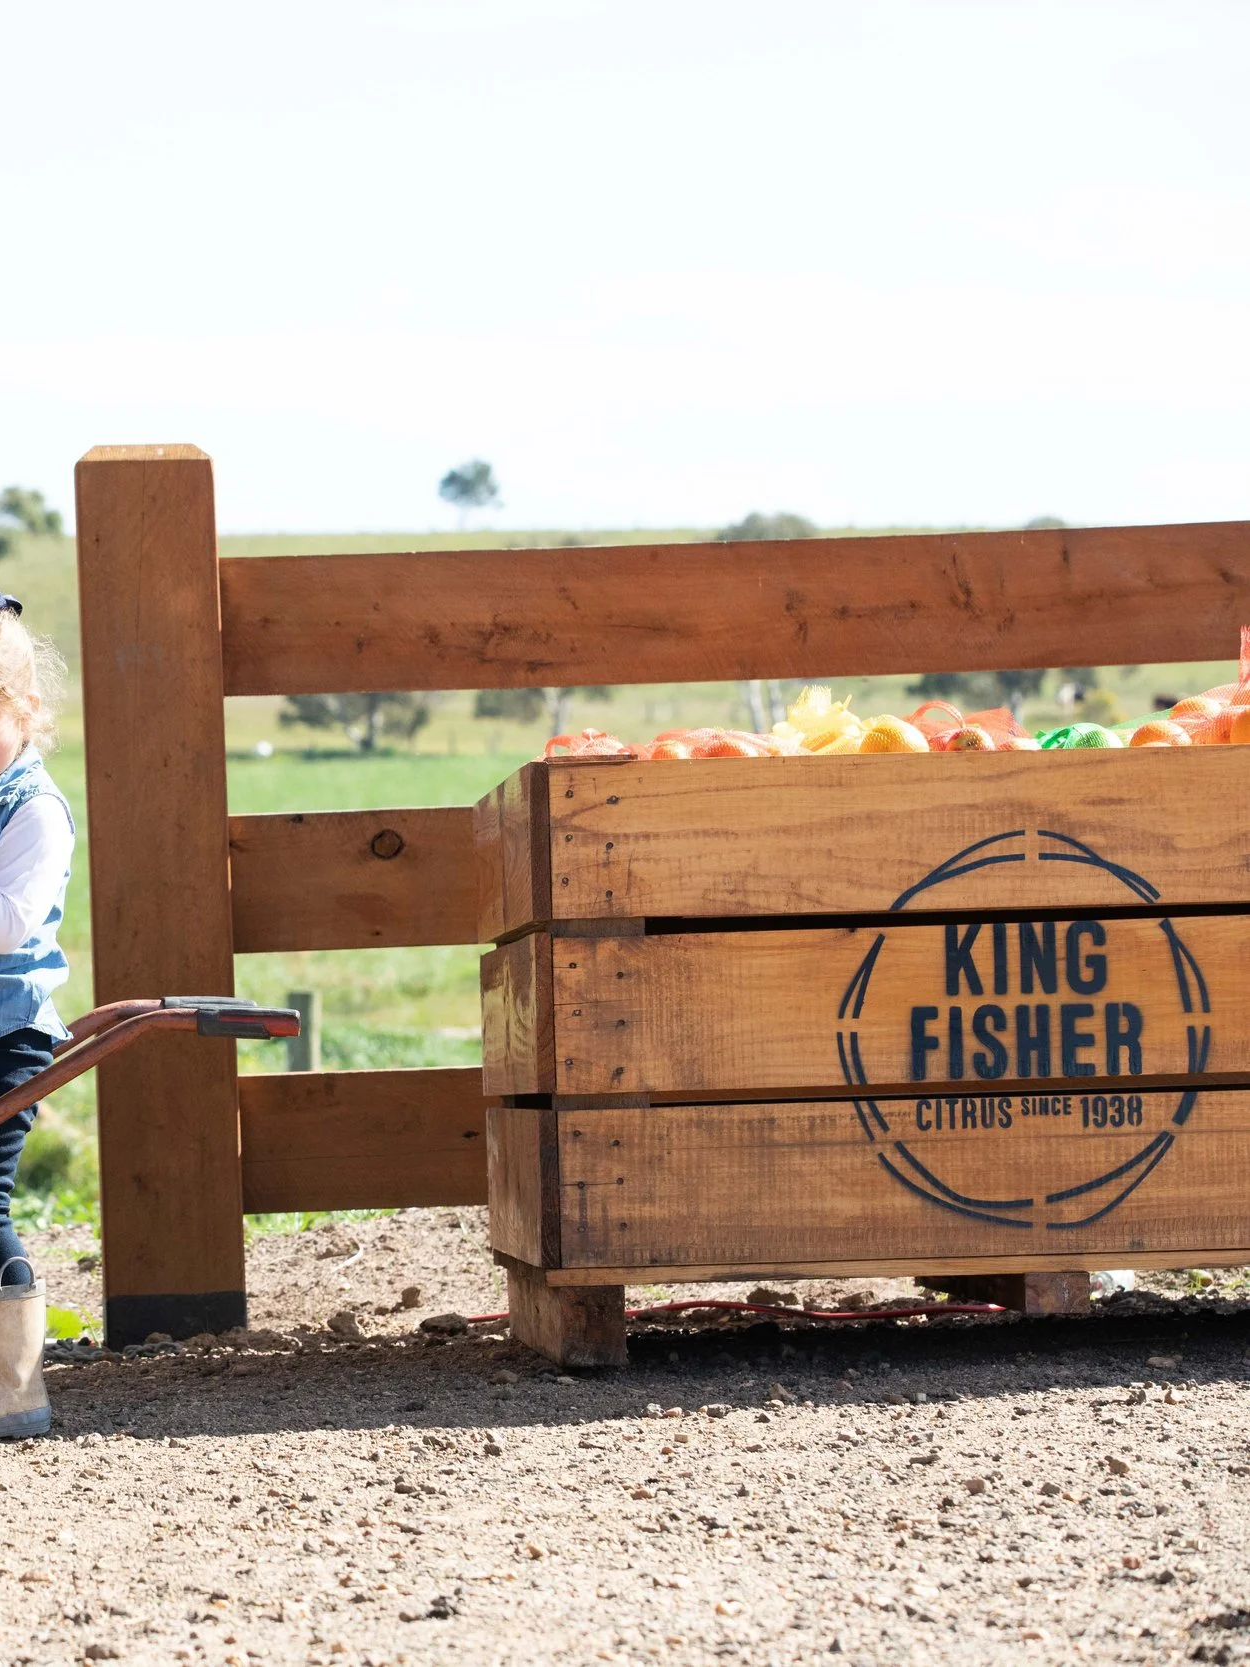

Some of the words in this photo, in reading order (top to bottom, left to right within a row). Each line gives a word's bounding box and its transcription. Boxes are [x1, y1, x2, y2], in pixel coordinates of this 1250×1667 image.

[945, 921, 1107, 995] KING
[911, 1003, 1143, 1081] FISHER
[916, 1097, 1013, 1131] CITRUS
[1021, 1097, 1072, 1116] SINCE
[1080, 1096, 1143, 1128] 1938
